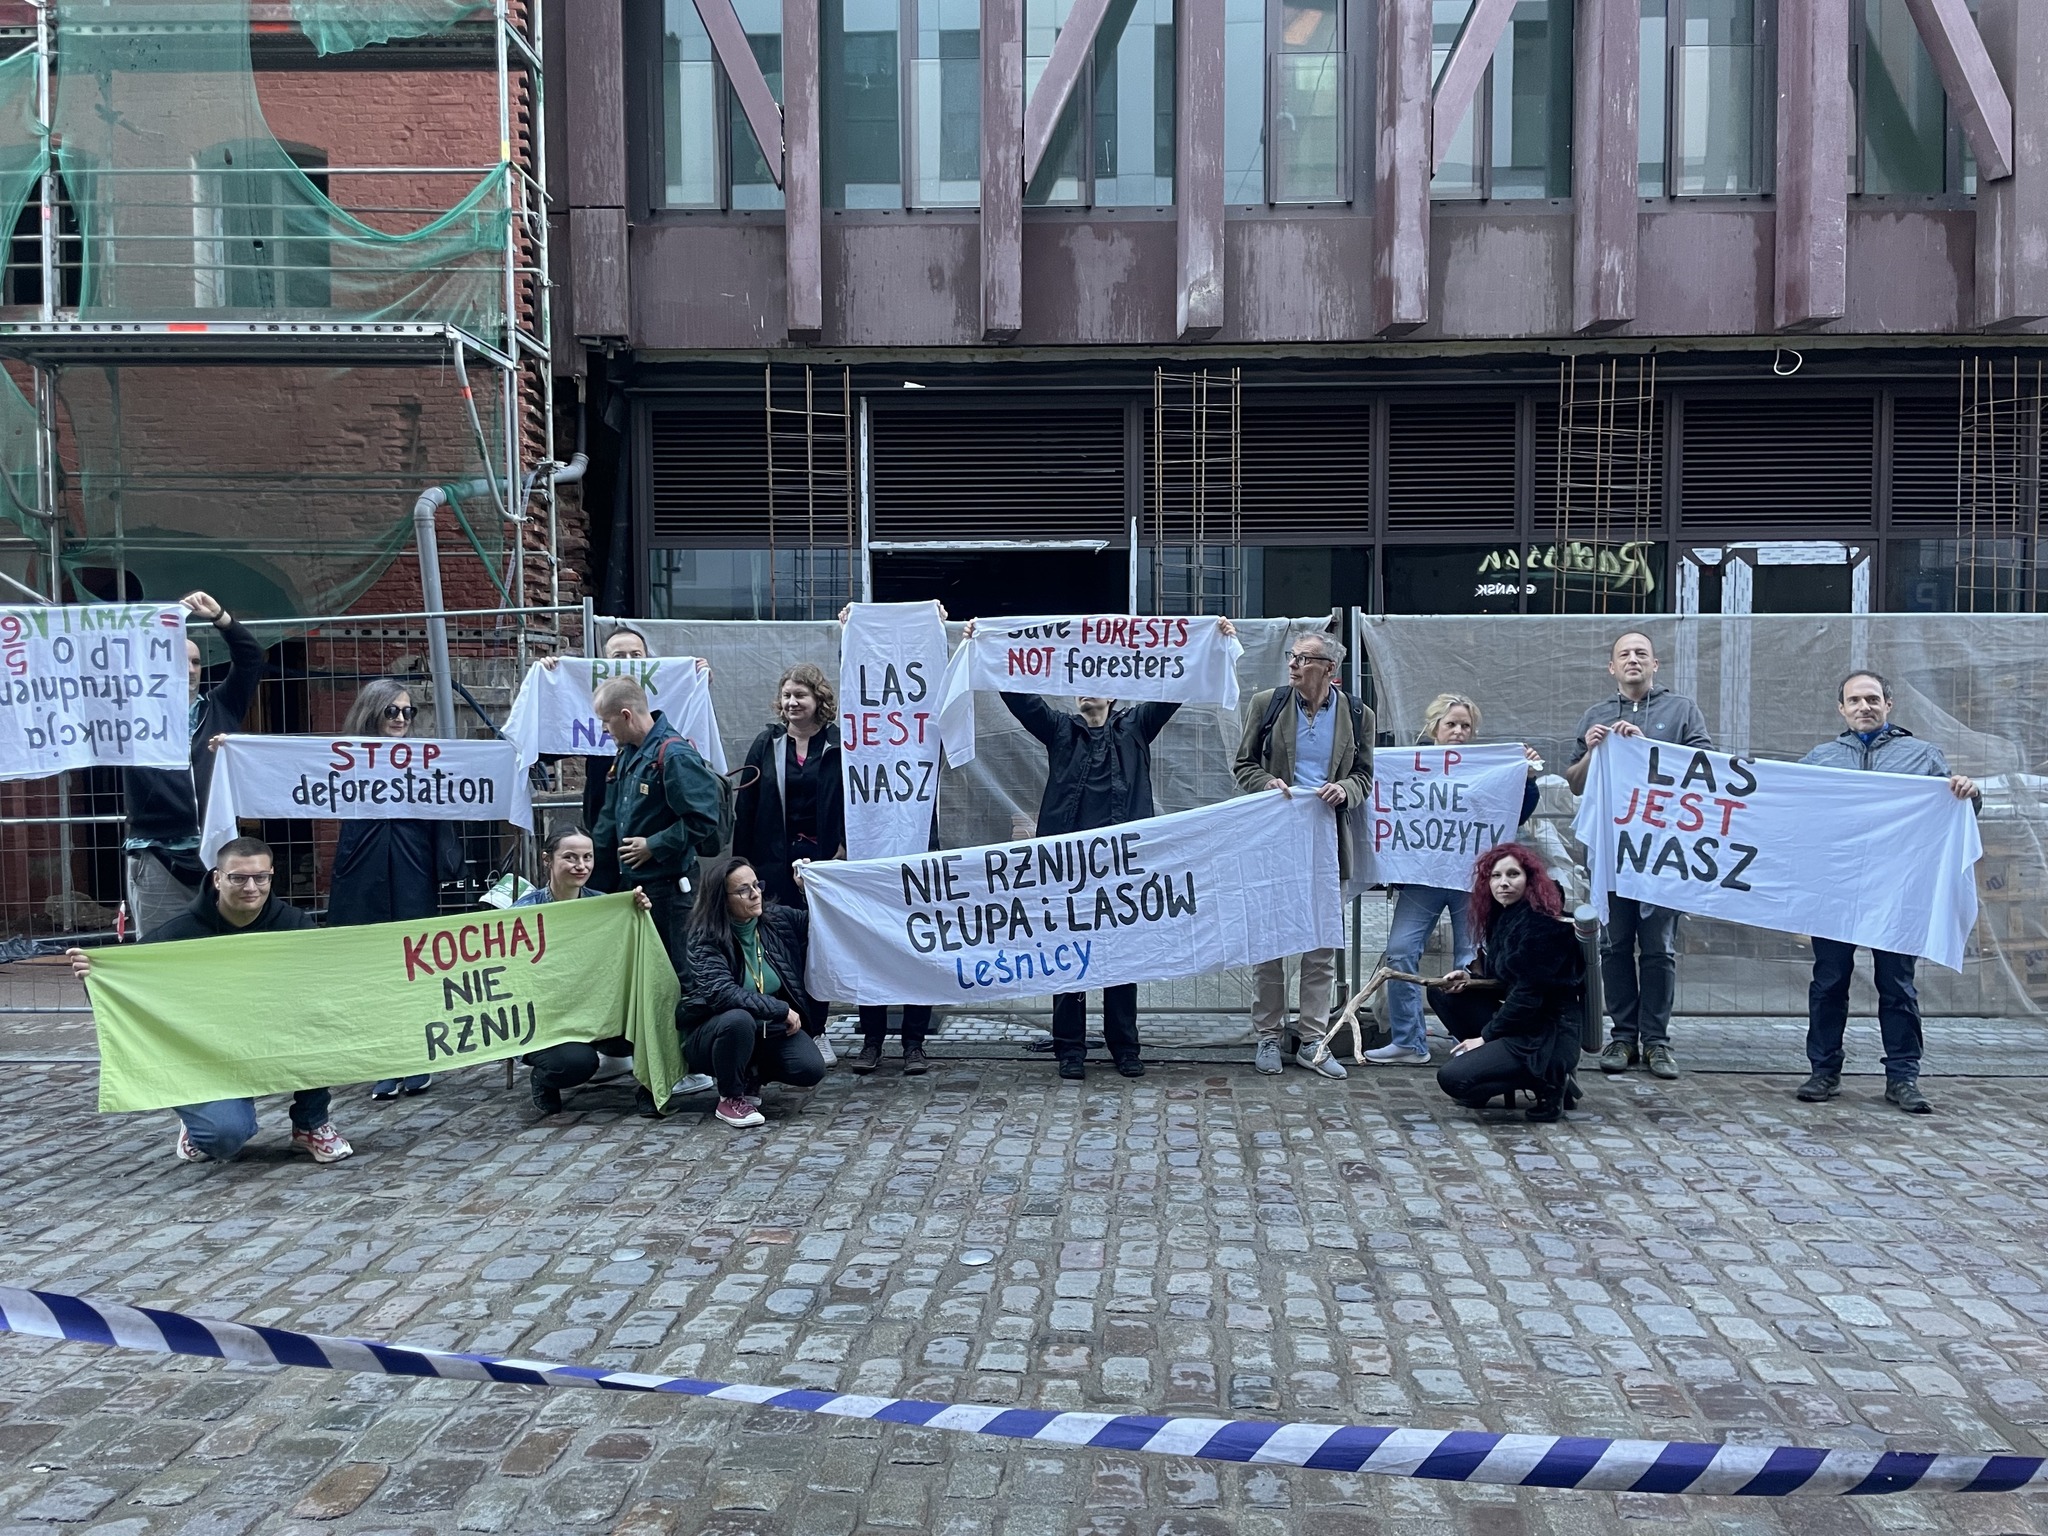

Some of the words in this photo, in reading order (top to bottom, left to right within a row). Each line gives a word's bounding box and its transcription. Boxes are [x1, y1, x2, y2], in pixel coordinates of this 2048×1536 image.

[1081, 617, 1190, 649] FORESTS
[860, 661, 928, 707] LAS
[1008, 647, 1056, 678] NOT
[1064, 647, 1186, 684] foresters
[24, 711, 168, 758] redukcja
[843, 711, 930, 751] JEST
[329, 741, 442, 771] STOP
[1647, 746, 1758, 797] LAS
[292, 767, 495, 813] deforestation
[849, 760, 934, 805] NASZ
[1374, 776, 1469, 813] LEŚNE
[1614, 788, 1748, 836] JEST
[901, 854, 971, 906] NIE
[1616, 830, 1759, 892] NASZ
[906, 896, 1034, 953] GŁUPA
[1041, 896, 1058, 932] i
[1067, 871, 1198, 932] LASÓW
[403, 912, 546, 982] KOCHAJ
[956, 939, 1092, 990] leśnicy
[442, 965, 514, 1012] NIE
